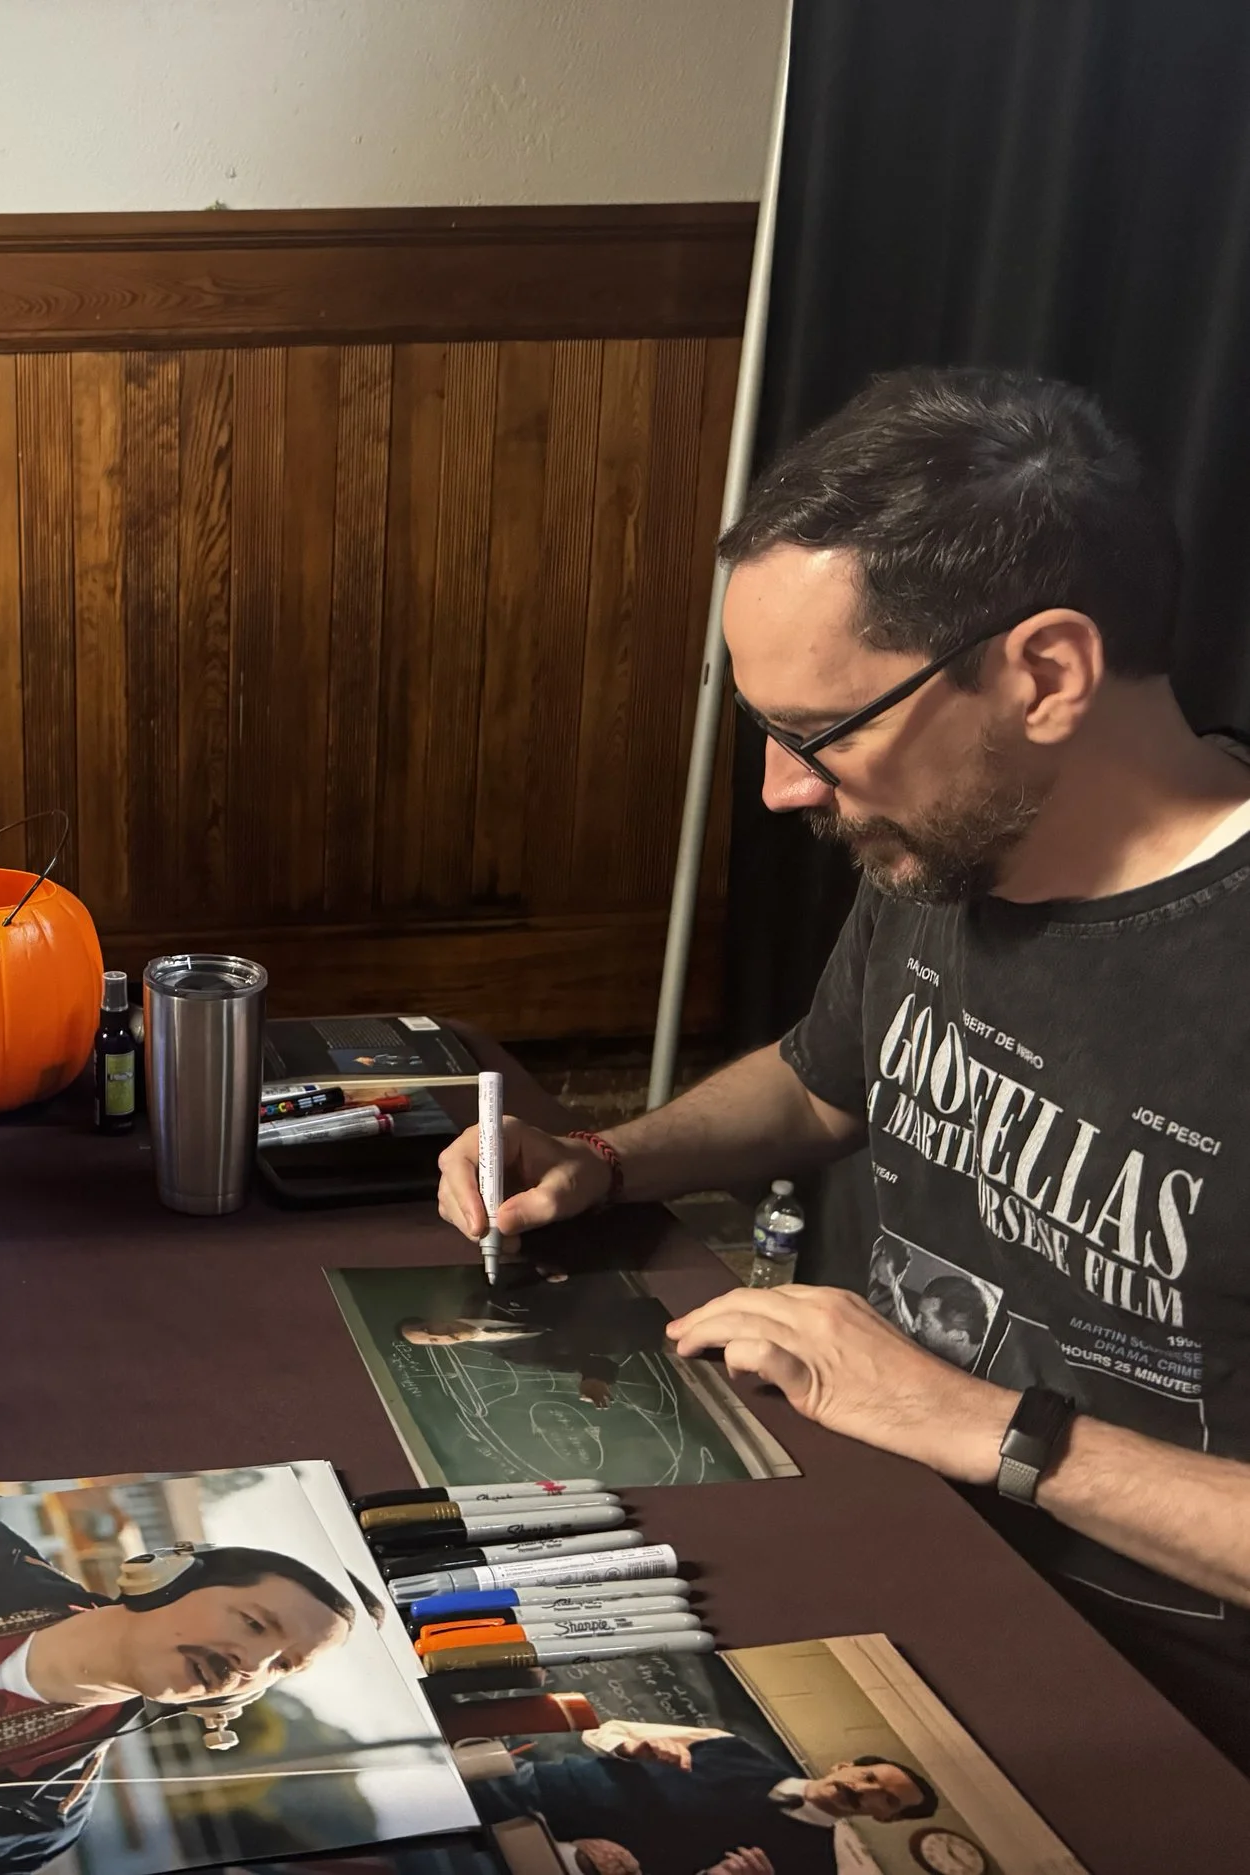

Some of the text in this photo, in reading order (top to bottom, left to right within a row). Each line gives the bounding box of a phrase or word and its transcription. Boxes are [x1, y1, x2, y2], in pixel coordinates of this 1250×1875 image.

[995, 1033, 1015, 1051] DE
[1131, 1107, 1222, 1156] JOE PESCI
[1084, 1247, 1184, 1328] FILM
[1070, 1317, 1127, 1345] MARTIN
[1061, 1344, 1202, 1395] HOURS 25 MINUTES
[1157, 1358, 1203, 1379] CRIME
[554, 1620, 611, 1636] Sharpie
